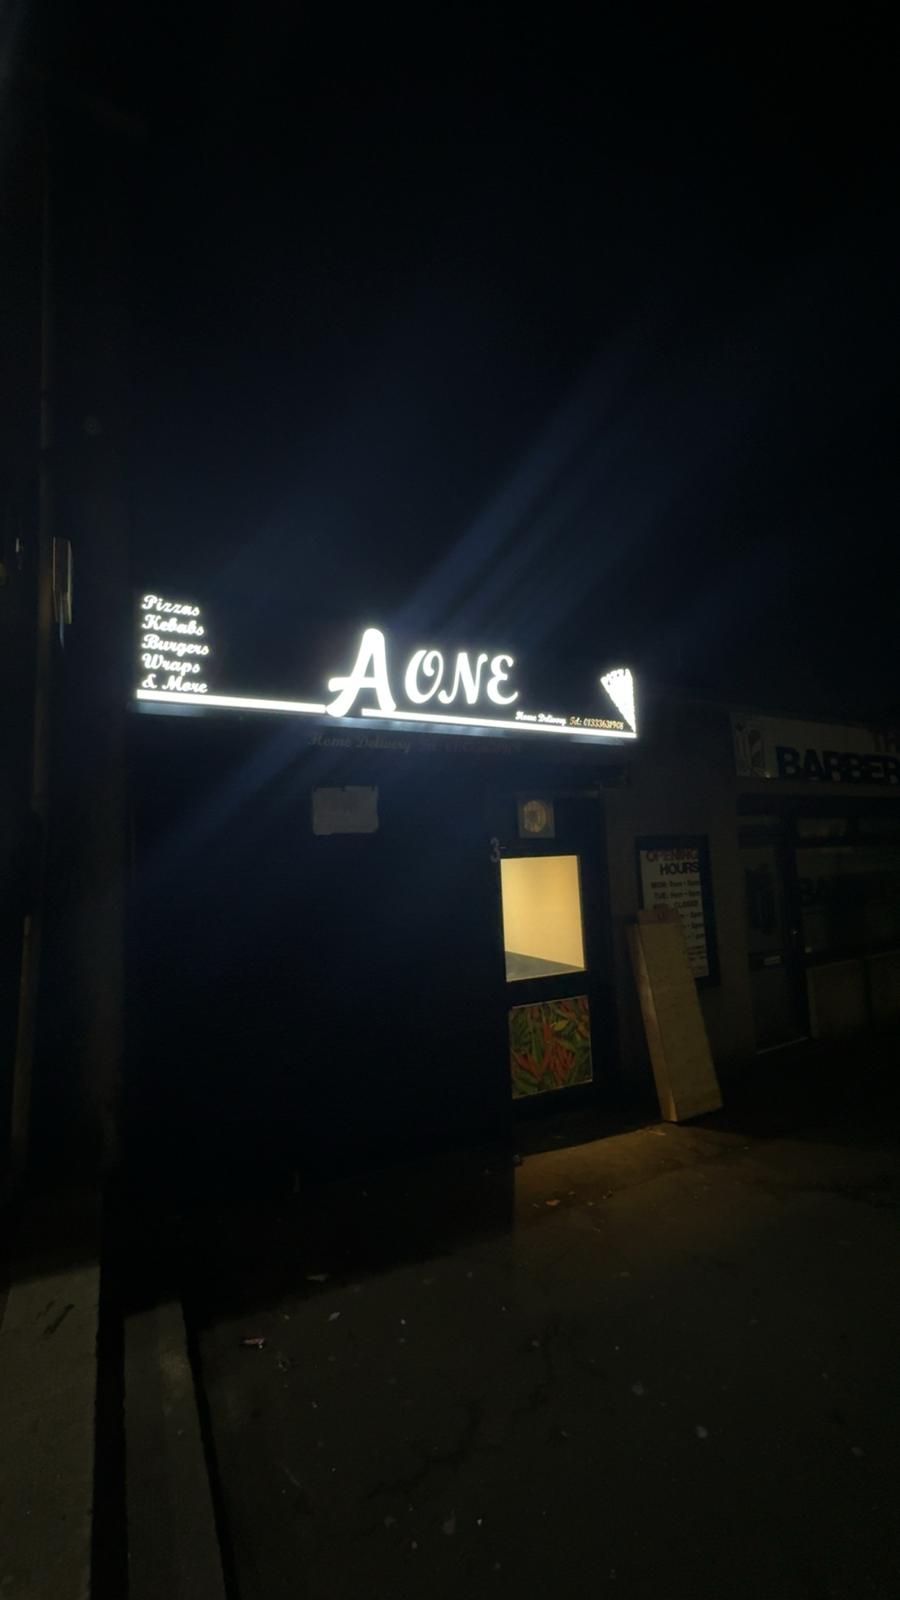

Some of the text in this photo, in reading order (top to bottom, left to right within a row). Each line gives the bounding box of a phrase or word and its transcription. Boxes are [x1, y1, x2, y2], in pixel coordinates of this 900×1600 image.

[141, 594, 201, 617] Pizzas
[142, 614, 205, 636] Kebabs
[141, 633, 210, 657] Burgers
[141, 653, 201, 677] Wraps
[328, 627, 519, 717] A ONE
[141, 674, 209, 694] & More
[659, 862, 701, 875] HOURS
